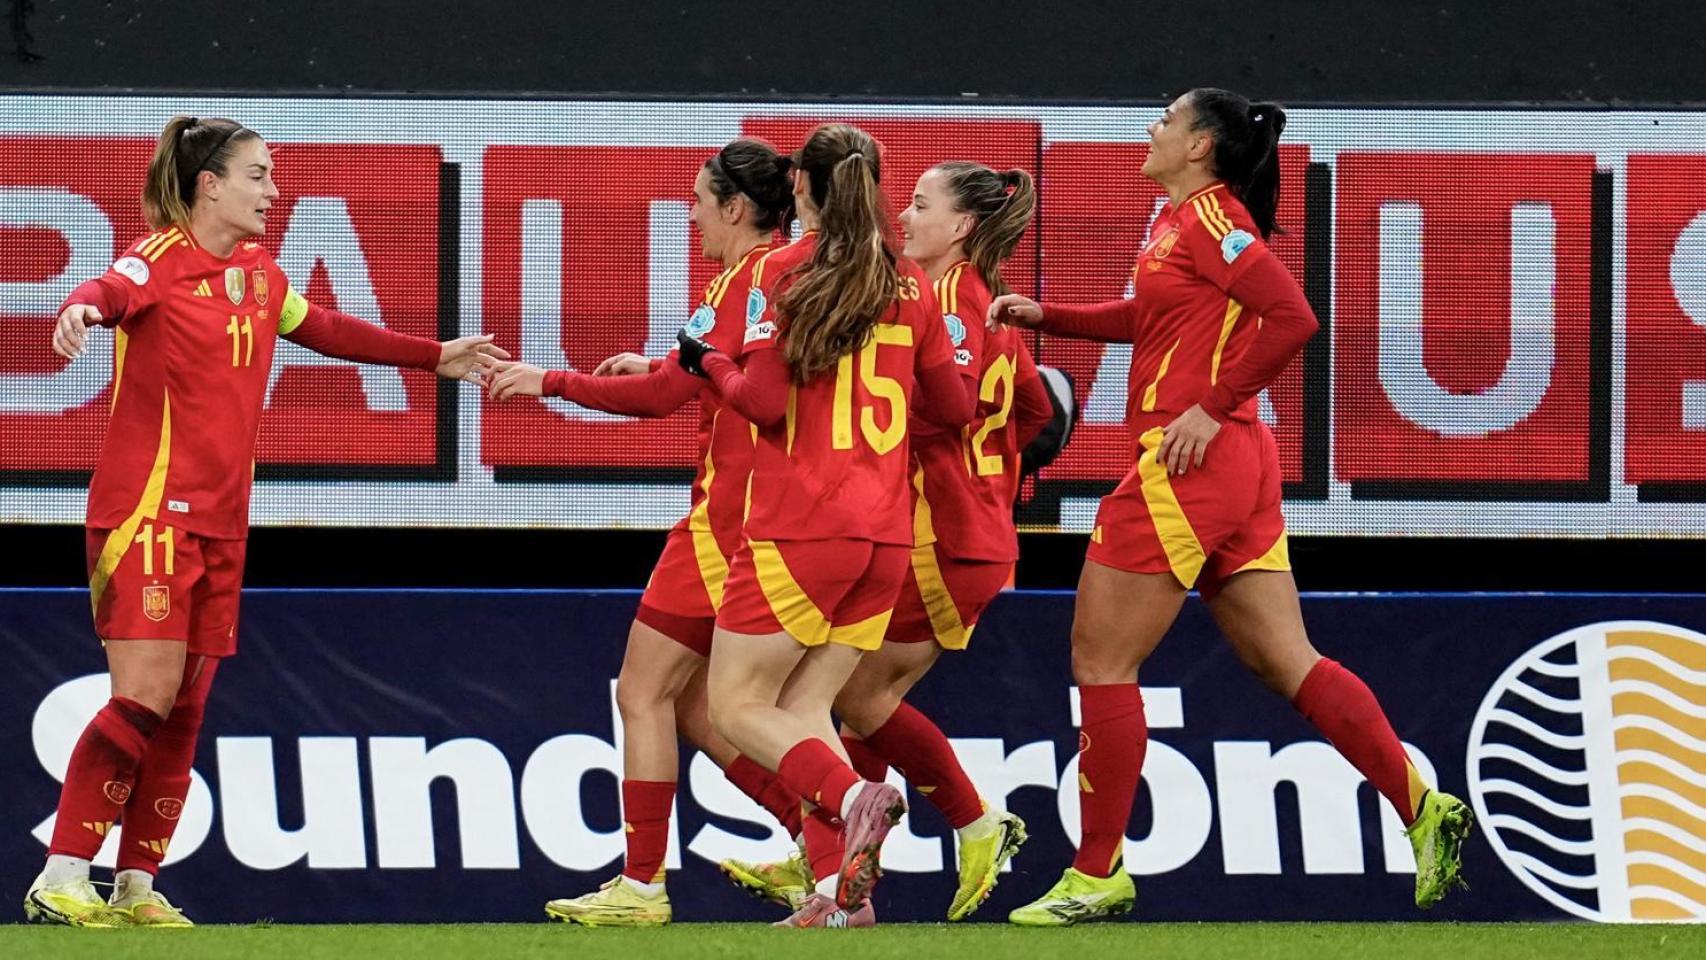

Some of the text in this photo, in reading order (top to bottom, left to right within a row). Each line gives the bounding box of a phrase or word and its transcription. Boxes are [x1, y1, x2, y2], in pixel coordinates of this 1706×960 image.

[226, 314, 253, 367] 11
[832, 322, 914, 456] 15
[135, 524, 175, 575] 11
